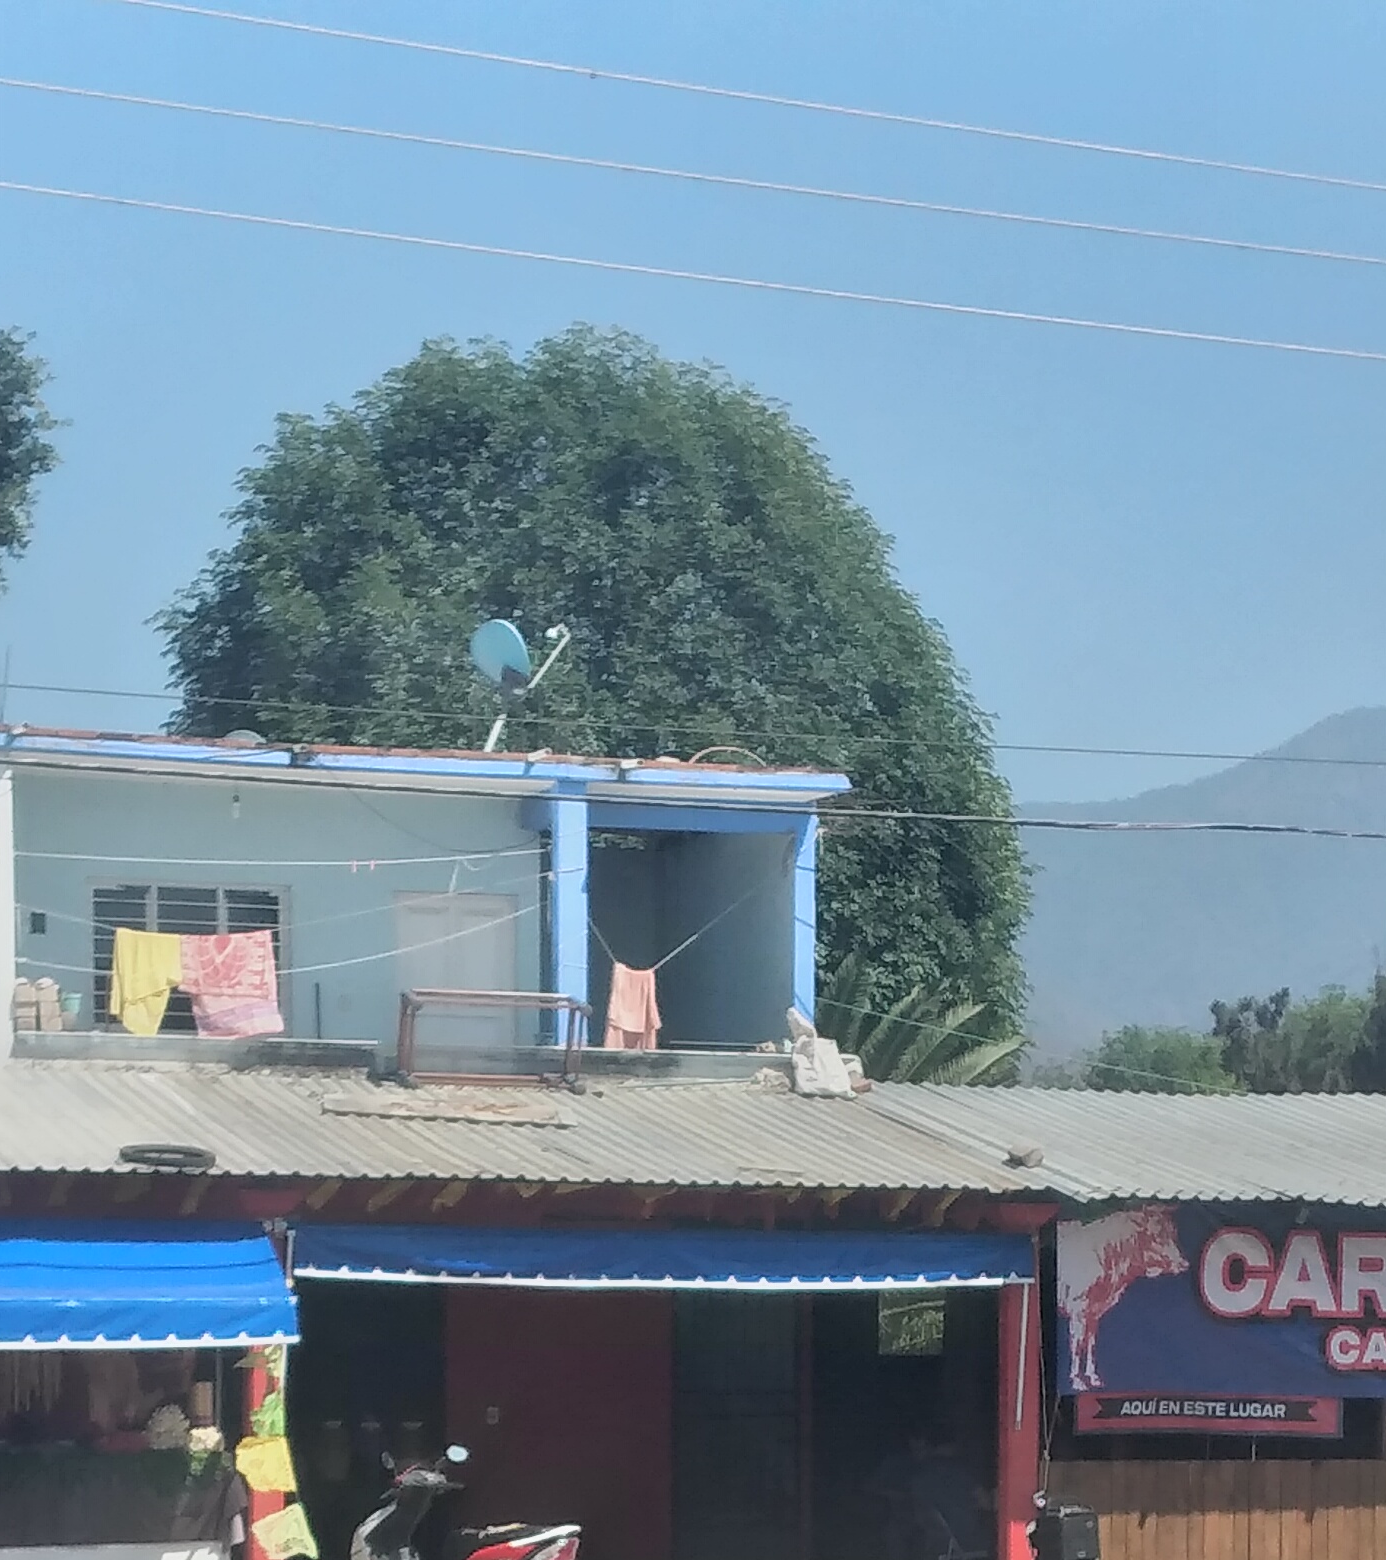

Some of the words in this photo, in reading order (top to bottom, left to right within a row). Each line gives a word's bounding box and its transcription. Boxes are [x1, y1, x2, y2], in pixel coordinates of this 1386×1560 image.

[1120, 1397, 1157, 1415] AQUÍ
[1162, 1400, 1180, 1415] EN
[1183, 1401, 1226, 1416] ESTE
[1229, 1402, 1286, 1418] LUGAR
